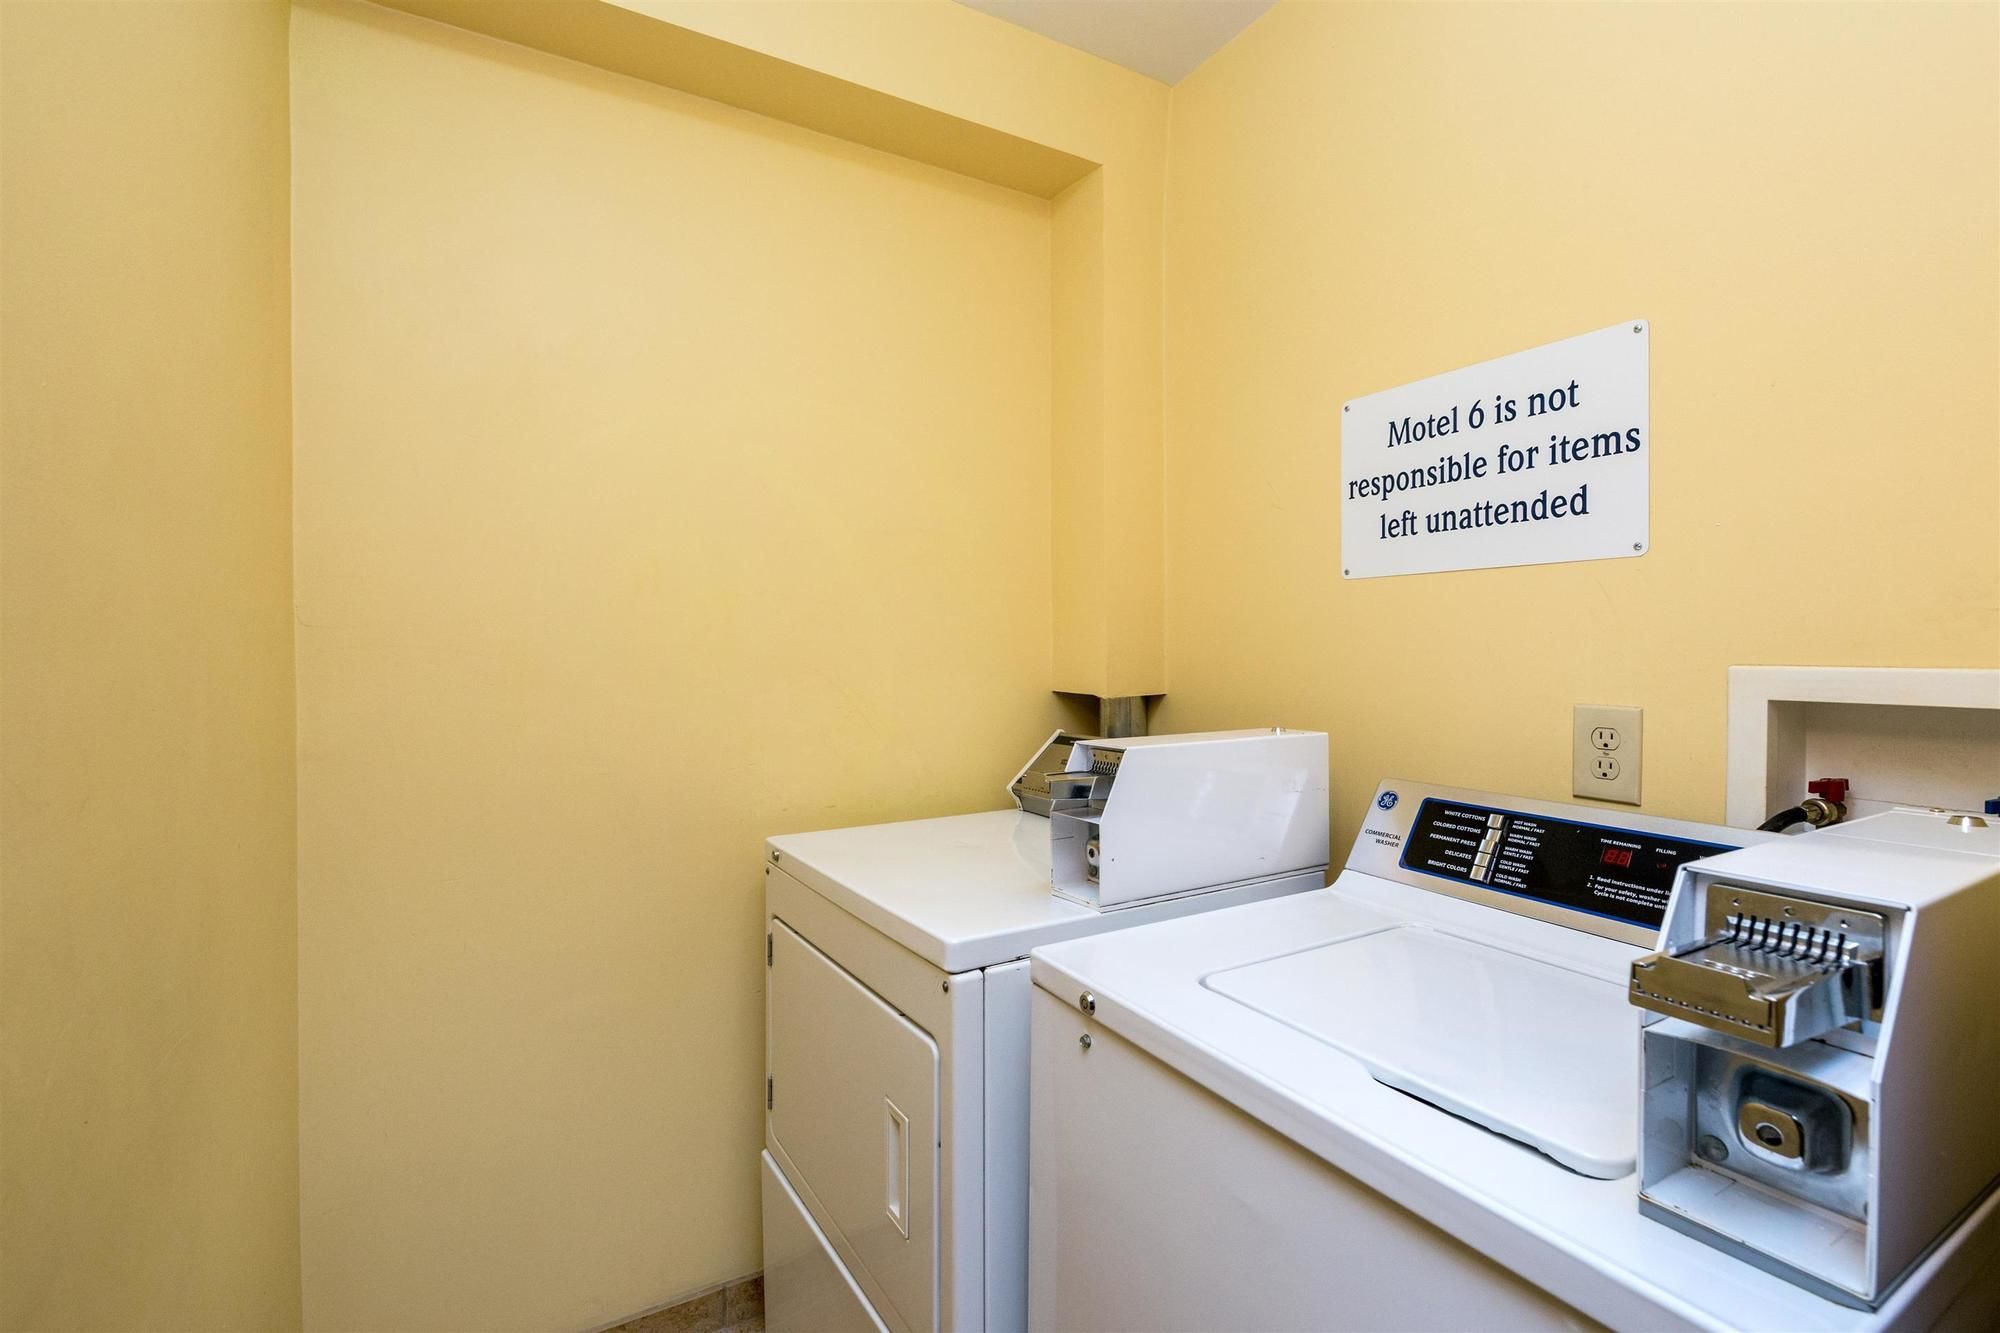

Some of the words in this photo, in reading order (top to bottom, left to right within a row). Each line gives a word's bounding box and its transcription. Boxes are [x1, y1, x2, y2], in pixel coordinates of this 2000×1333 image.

[1387, 406, 1459, 448] Motel
[1468, 400, 1485, 429] 6
[1494, 395, 1517, 424] is
[1527, 379, 1580, 417] not
[1348, 452, 1488, 501] responsible
[1497, 444, 1539, 475] for
[1548, 427, 1642, 466] items
[1380, 510, 1418, 539] left
[1426, 484, 1589, 534] unattended
[1379, 791, 1397, 809] GE
[1461, 813, 1486, 821] COTTONS
[1432, 820, 1456, 829] COLORED
[1456, 825, 1481, 834] COTTONS
[1365, 828, 1401, 841] COMMERCIAL
[1429, 833, 1460, 844] PERMANENT
[1460, 839, 1476, 847] PRESS
[1375, 838, 1400, 848] WASHER
[1612, 840, 1641, 850] REMAINING
[1444, 850, 1472, 860] DELICATES
[1655, 848, 1676, 856] FILLING
[1427, 859, 1446, 868] BRIGHT
[1446, 864, 1467, 873] COLORS
[1611, 879, 1645, 891] instructions
[1625, 897, 1654, 907] complete
[1638, 894, 1660, 902] washer
